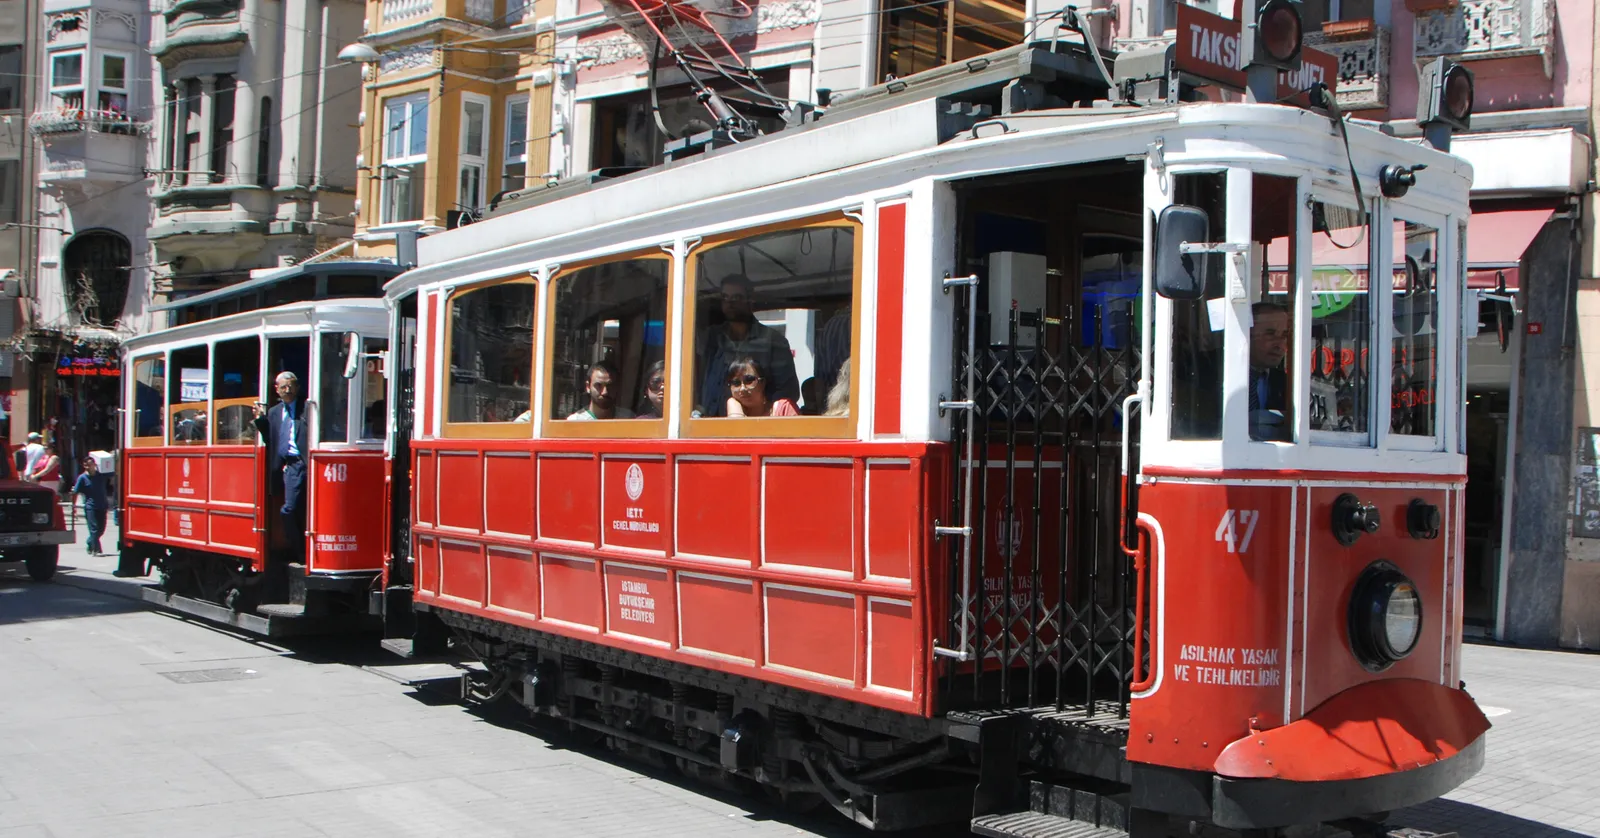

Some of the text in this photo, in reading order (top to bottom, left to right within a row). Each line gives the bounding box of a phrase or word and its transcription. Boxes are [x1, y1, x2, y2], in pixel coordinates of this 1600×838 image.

[1190, 24, 1241, 71] TAKSİ
[1215, 509, 1259, 553] 47
[1180, 644, 1279, 665] ASILMAK YASAK
[1174, 664, 1190, 682] VE
